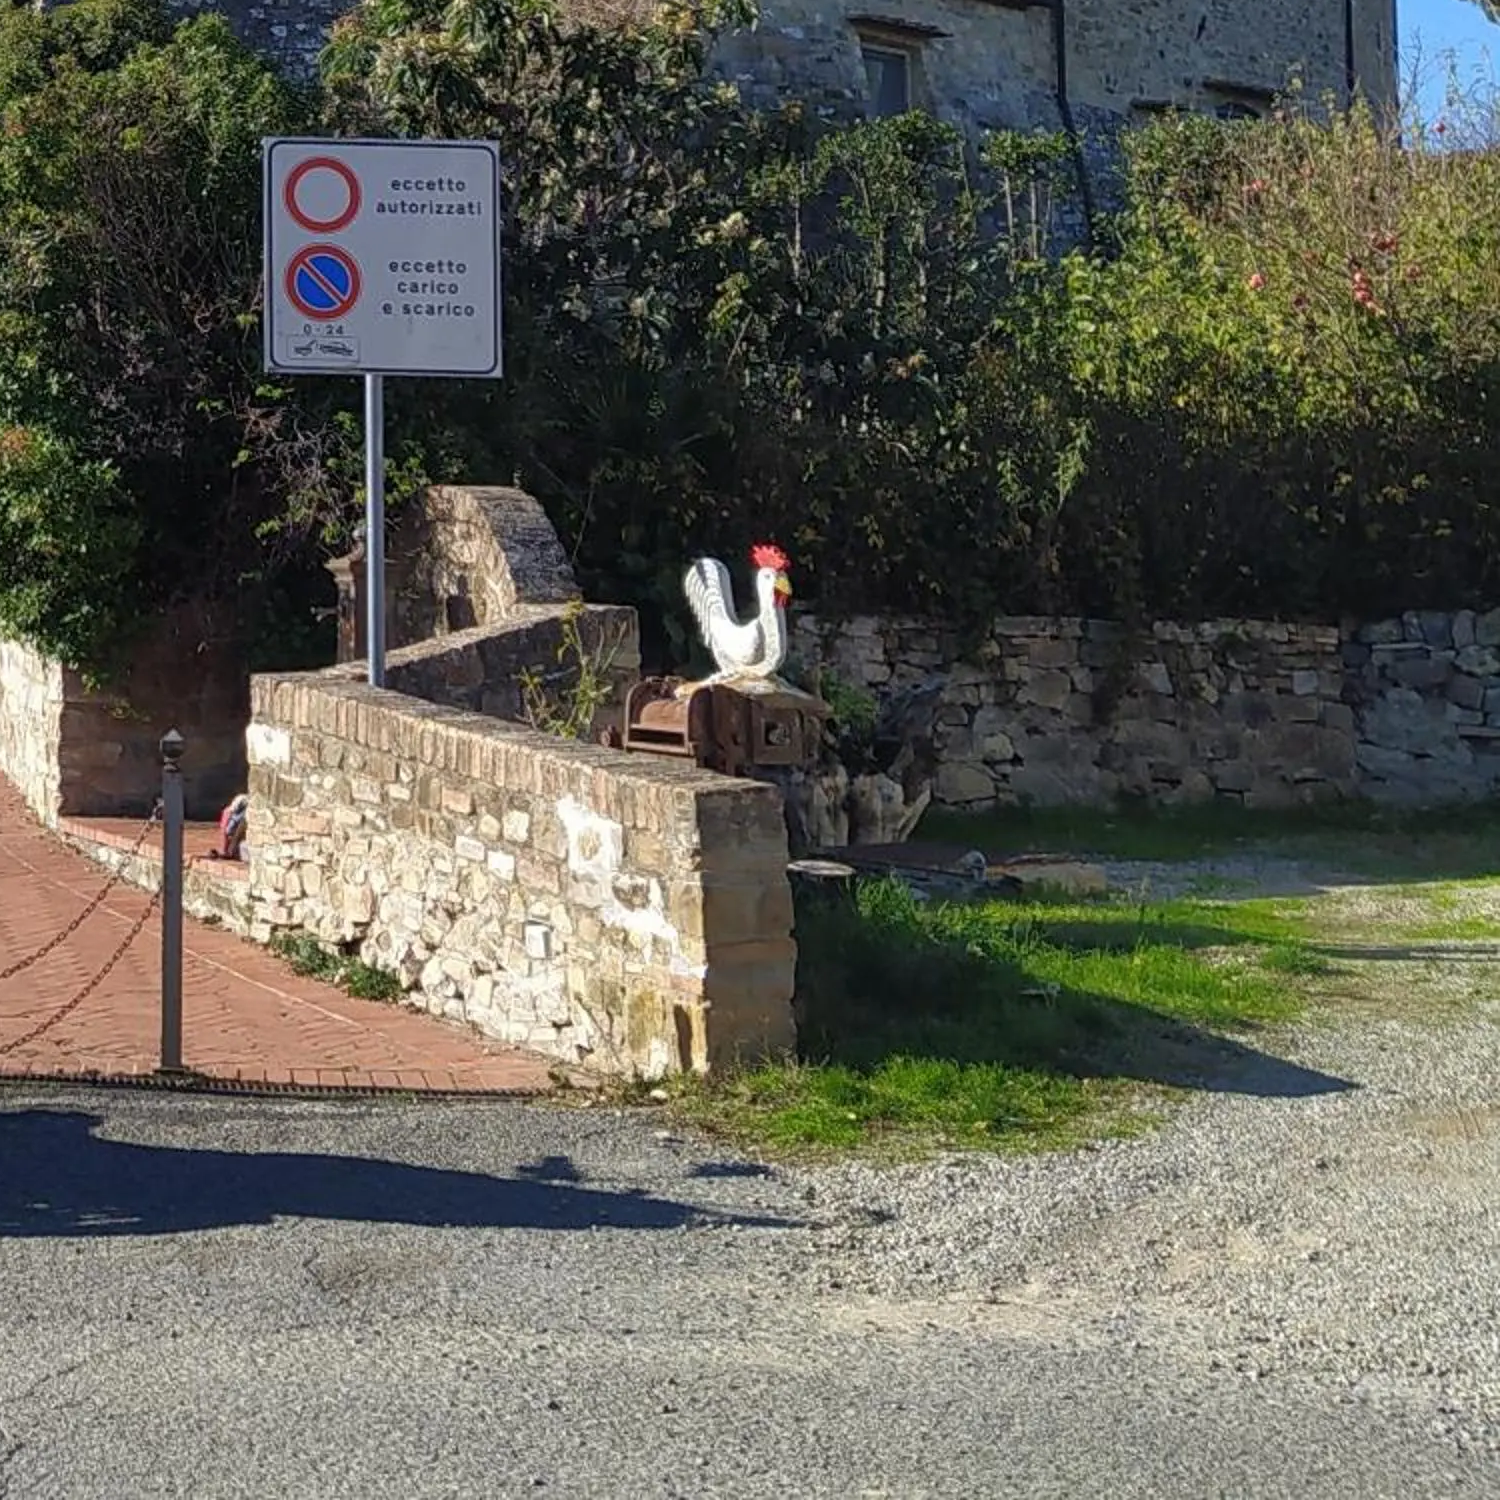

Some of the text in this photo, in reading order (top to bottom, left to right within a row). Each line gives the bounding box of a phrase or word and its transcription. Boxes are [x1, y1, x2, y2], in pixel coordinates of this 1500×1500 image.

[391, 177, 467, 192] eccetto
[376, 201, 482, 216] autorizzati
[389, 259, 467, 274] eccetto
[397, 280, 459, 295] carico
[382, 302, 475, 317] e scarico
[326, 324, 344, 335] 24
